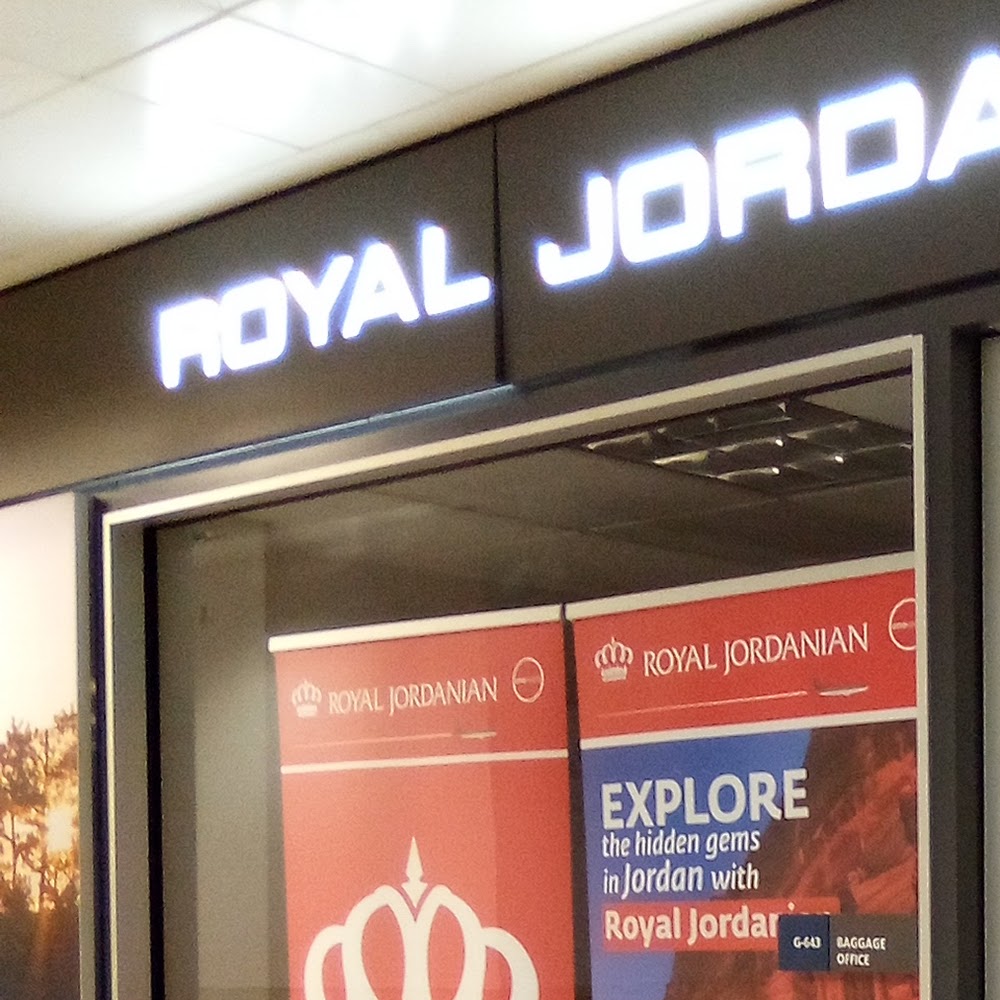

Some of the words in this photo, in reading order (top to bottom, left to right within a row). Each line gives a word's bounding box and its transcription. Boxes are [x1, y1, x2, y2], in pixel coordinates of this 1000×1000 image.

[154, 222, 493, 390] ROYAL
[645, 643, 717, 677] ROYAL
[723, 622, 869, 676] JORDANIAN
[328, 688, 384, 715] ROYAL
[388, 676, 499, 717] JORDANIAN
[601, 767, 811, 830] EXPLORE
[602, 831, 631, 858] the
[635, 828, 700, 857] hidden
[705, 829, 761, 860] gems
[603, 868, 619, 895] in
[621, 858, 705, 900] Jordan
[711, 862, 760, 891] with
[605, 906, 682, 949] Royal
[836, 936, 886, 951] BAGGAGE
[836, 952, 870, 967] OFFICE
